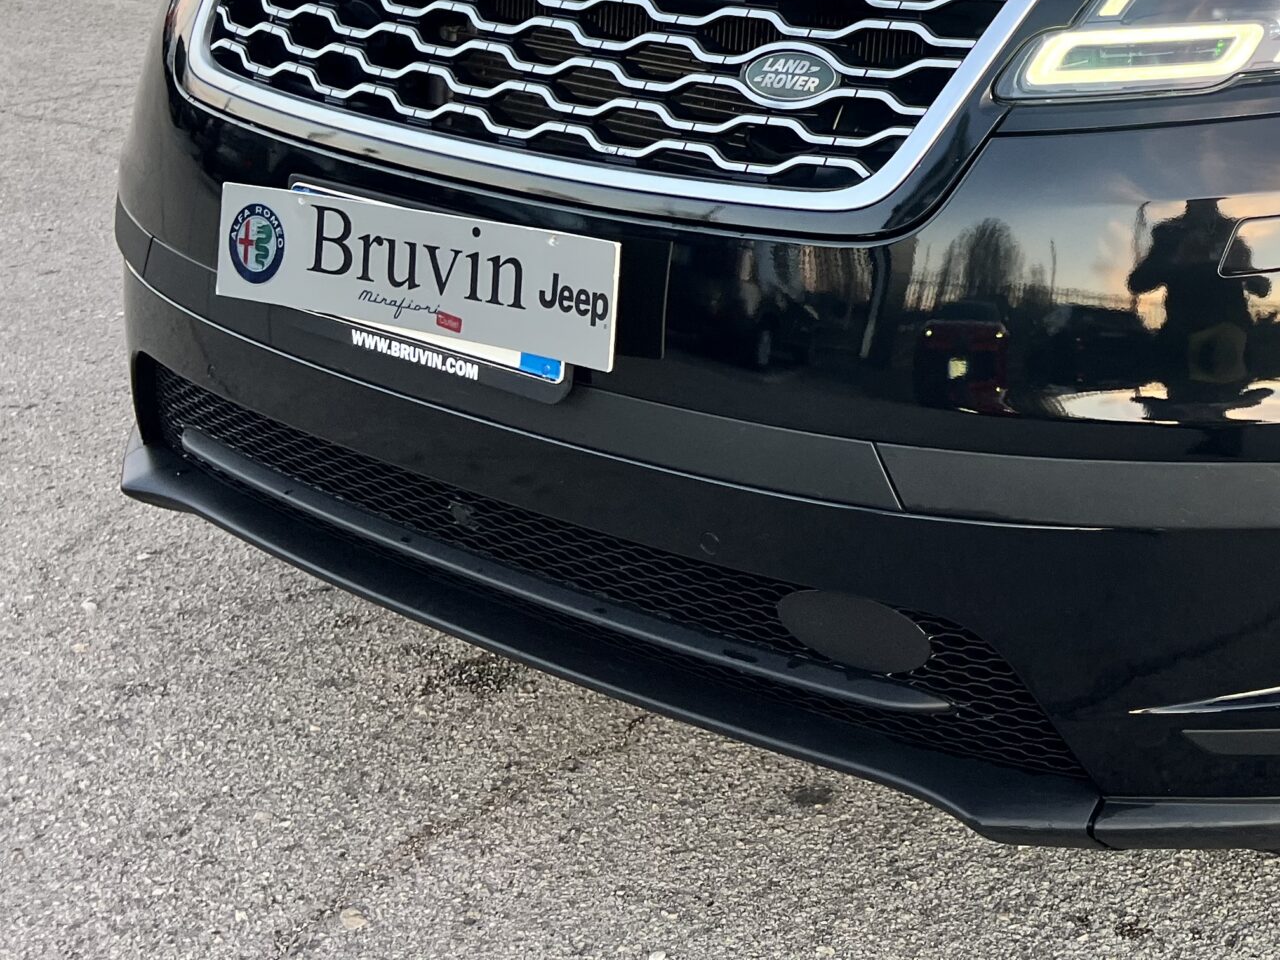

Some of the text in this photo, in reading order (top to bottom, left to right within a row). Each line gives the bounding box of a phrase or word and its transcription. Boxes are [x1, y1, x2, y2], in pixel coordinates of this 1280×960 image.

[230, 206, 284, 248] ALFA ROMEO
[306, 204, 527, 310] Bruvin
[539, 272, 609, 327] Jeep
[351, 328, 479, 381] WWW.BRUVIN.COM
